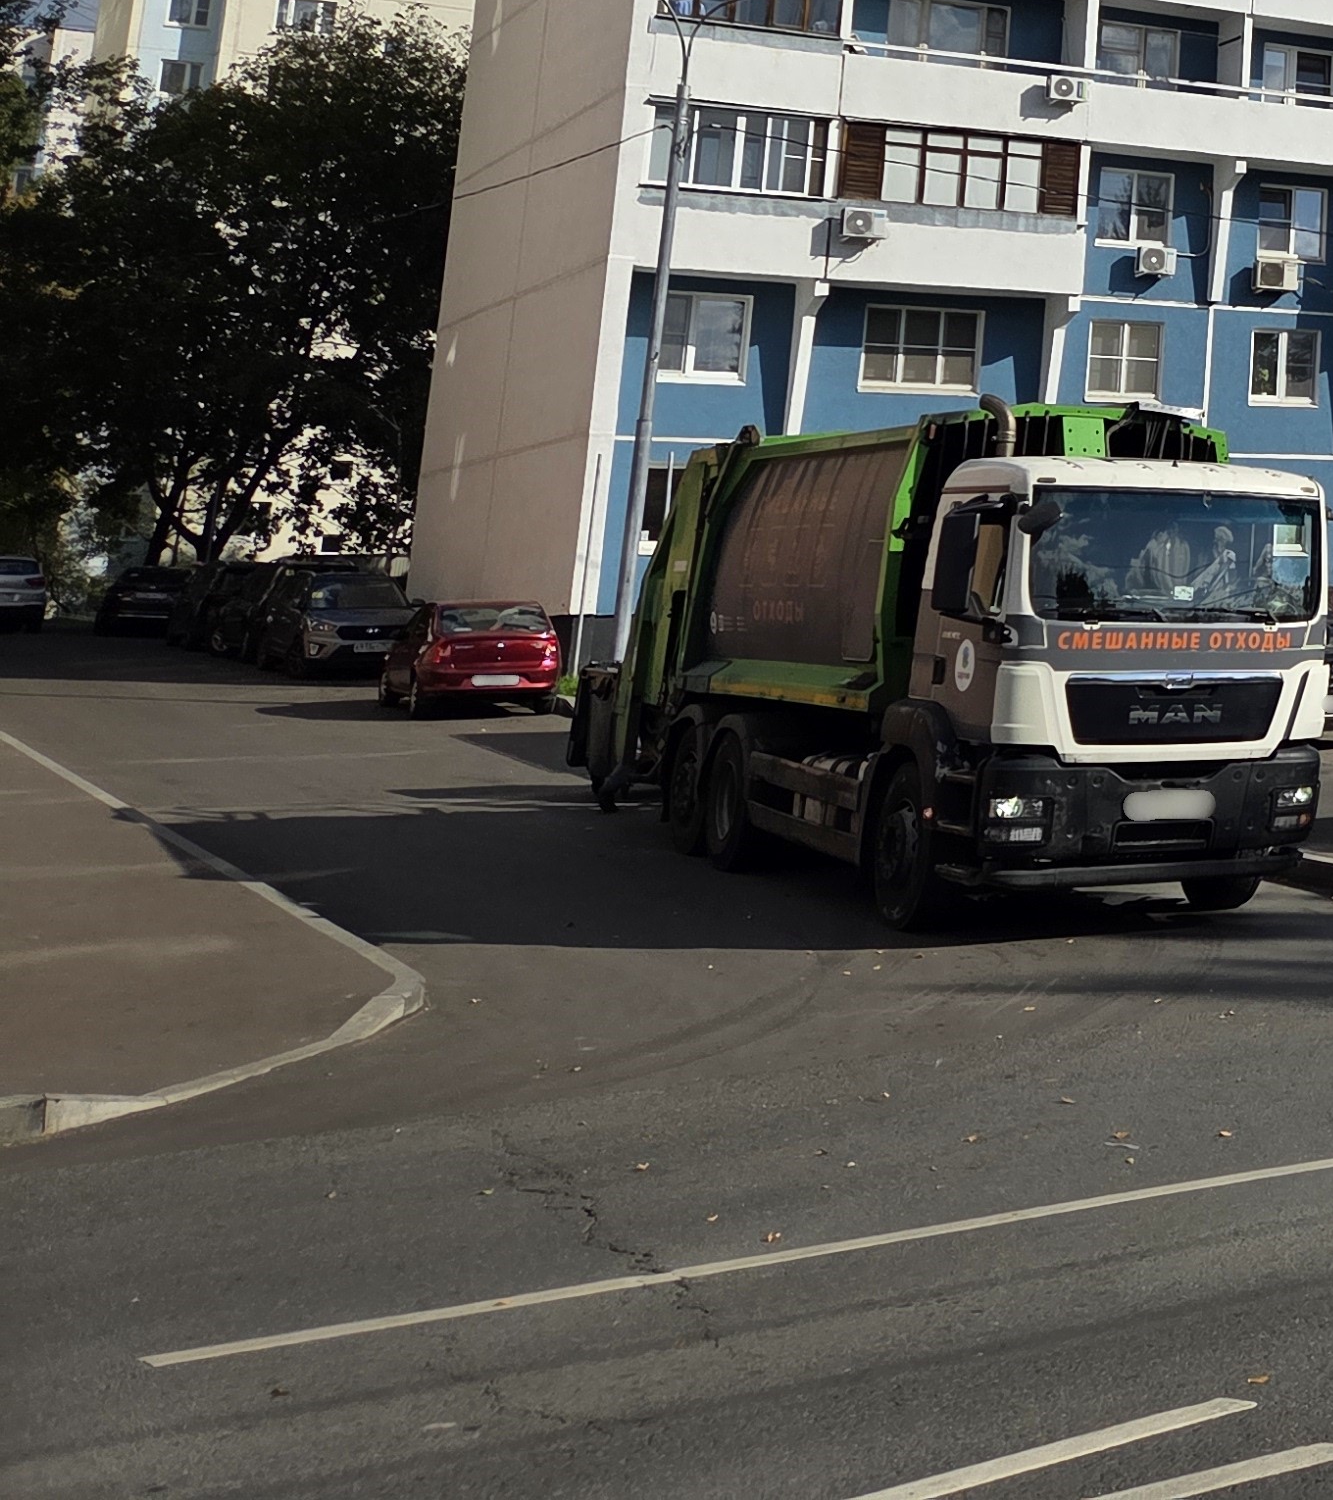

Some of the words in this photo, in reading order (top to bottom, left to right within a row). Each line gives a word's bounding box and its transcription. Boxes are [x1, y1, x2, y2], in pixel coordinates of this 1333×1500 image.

[1057, 630, 1201, 650] СМЕШАННЫЕ
[1209, 631, 1292, 653] ОТХОДЫ
[1128, 703, 1223, 725] MAN
